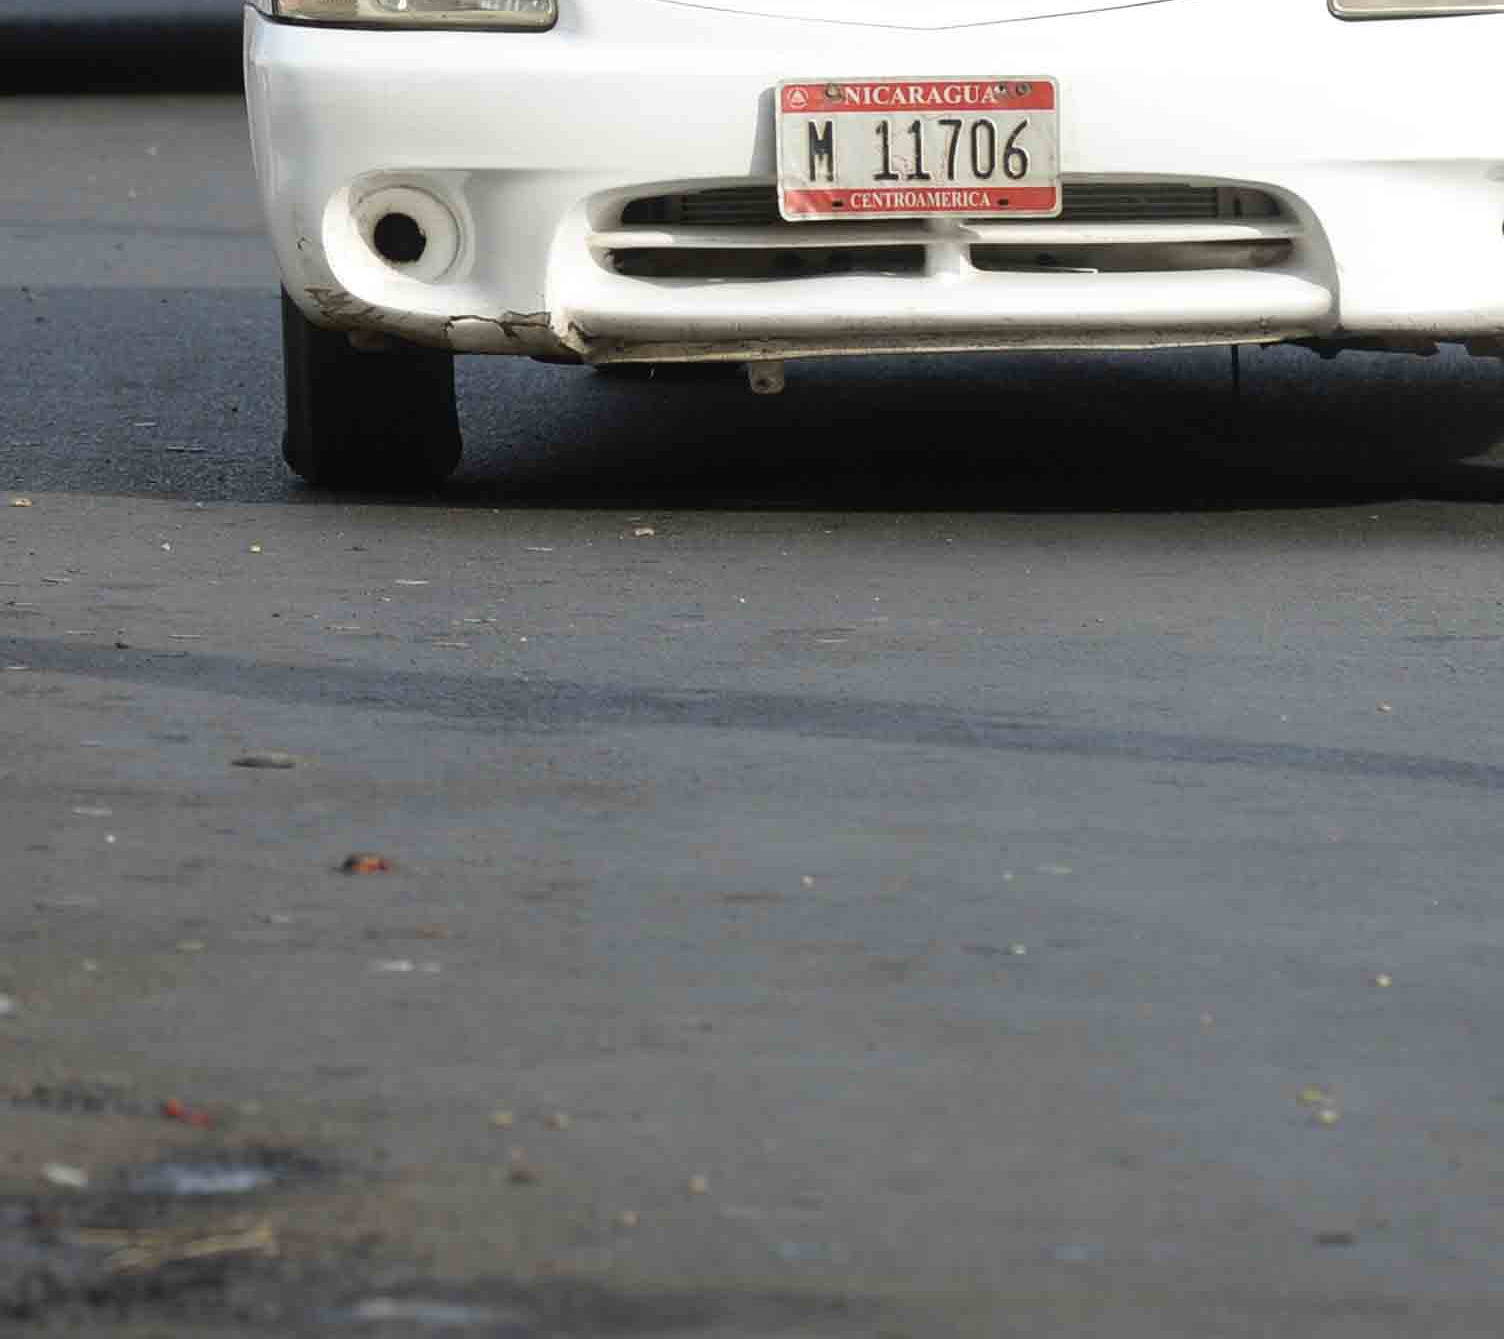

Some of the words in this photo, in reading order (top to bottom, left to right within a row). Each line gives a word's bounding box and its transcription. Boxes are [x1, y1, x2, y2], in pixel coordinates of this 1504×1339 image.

[844, 84, 997, 105] NICARAGUA
[807, 120, 834, 182] M
[872, 119, 1029, 180] 11706
[849, 191, 991, 209] CENTROAMERICA
